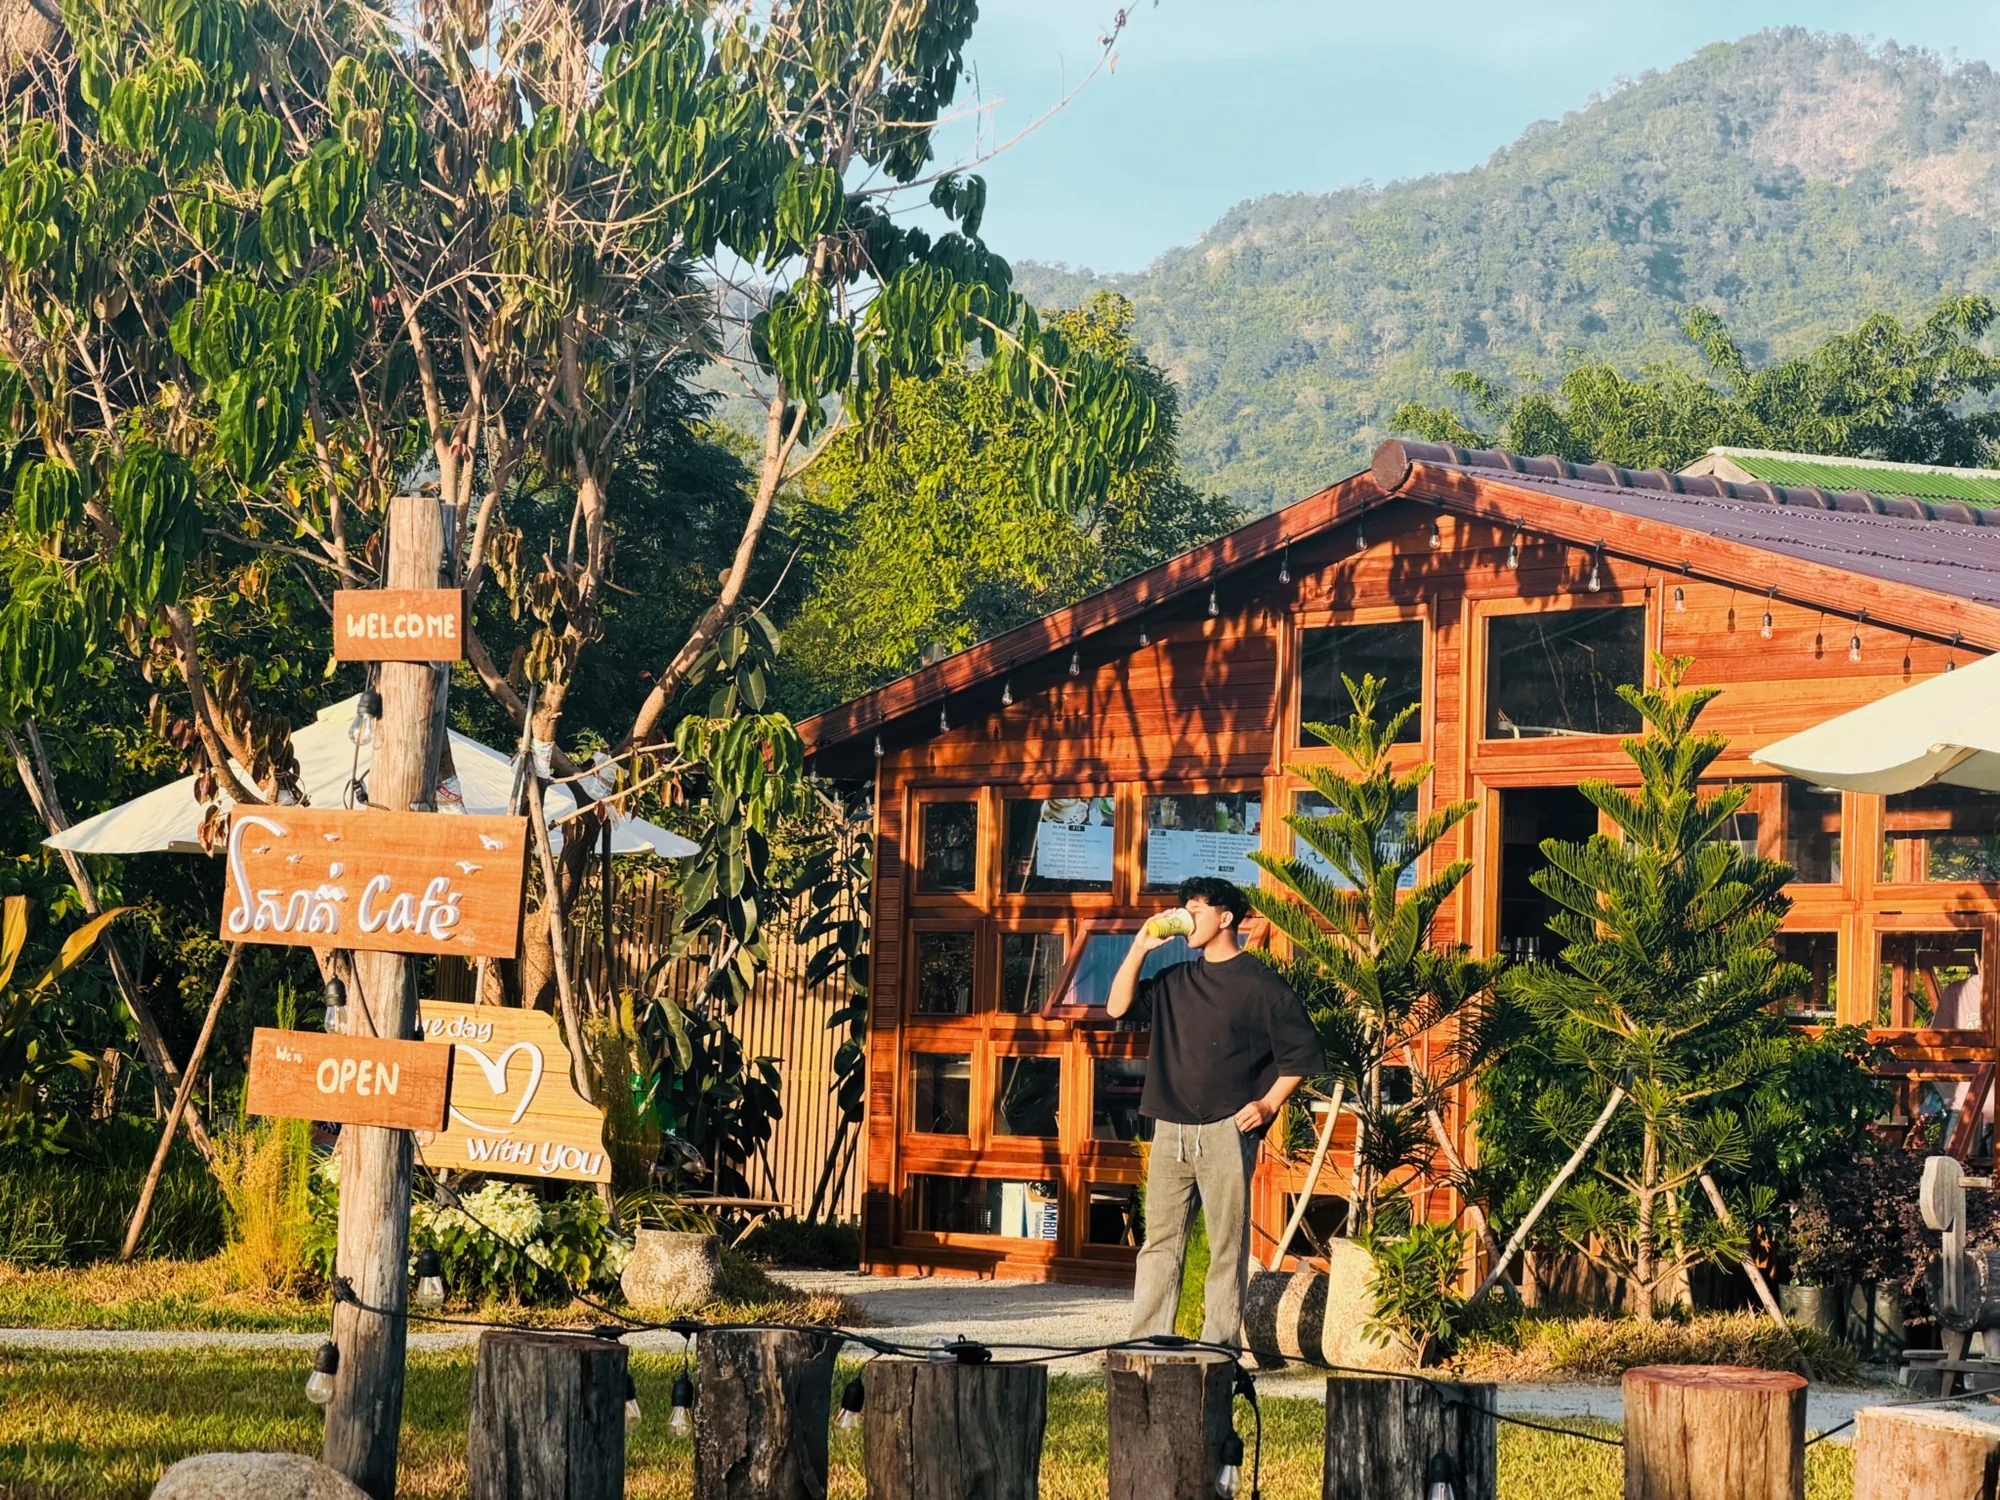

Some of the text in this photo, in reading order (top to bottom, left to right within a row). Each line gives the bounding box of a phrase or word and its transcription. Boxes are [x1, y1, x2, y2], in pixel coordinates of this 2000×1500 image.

[346, 612, 456, 640] WELCOME
[358, 874, 463, 941] Café
[447, 1016, 494, 1044] day
[316, 1058, 400, 1096] OPEN
[1042, 1202, 1058, 1240] AMBO
